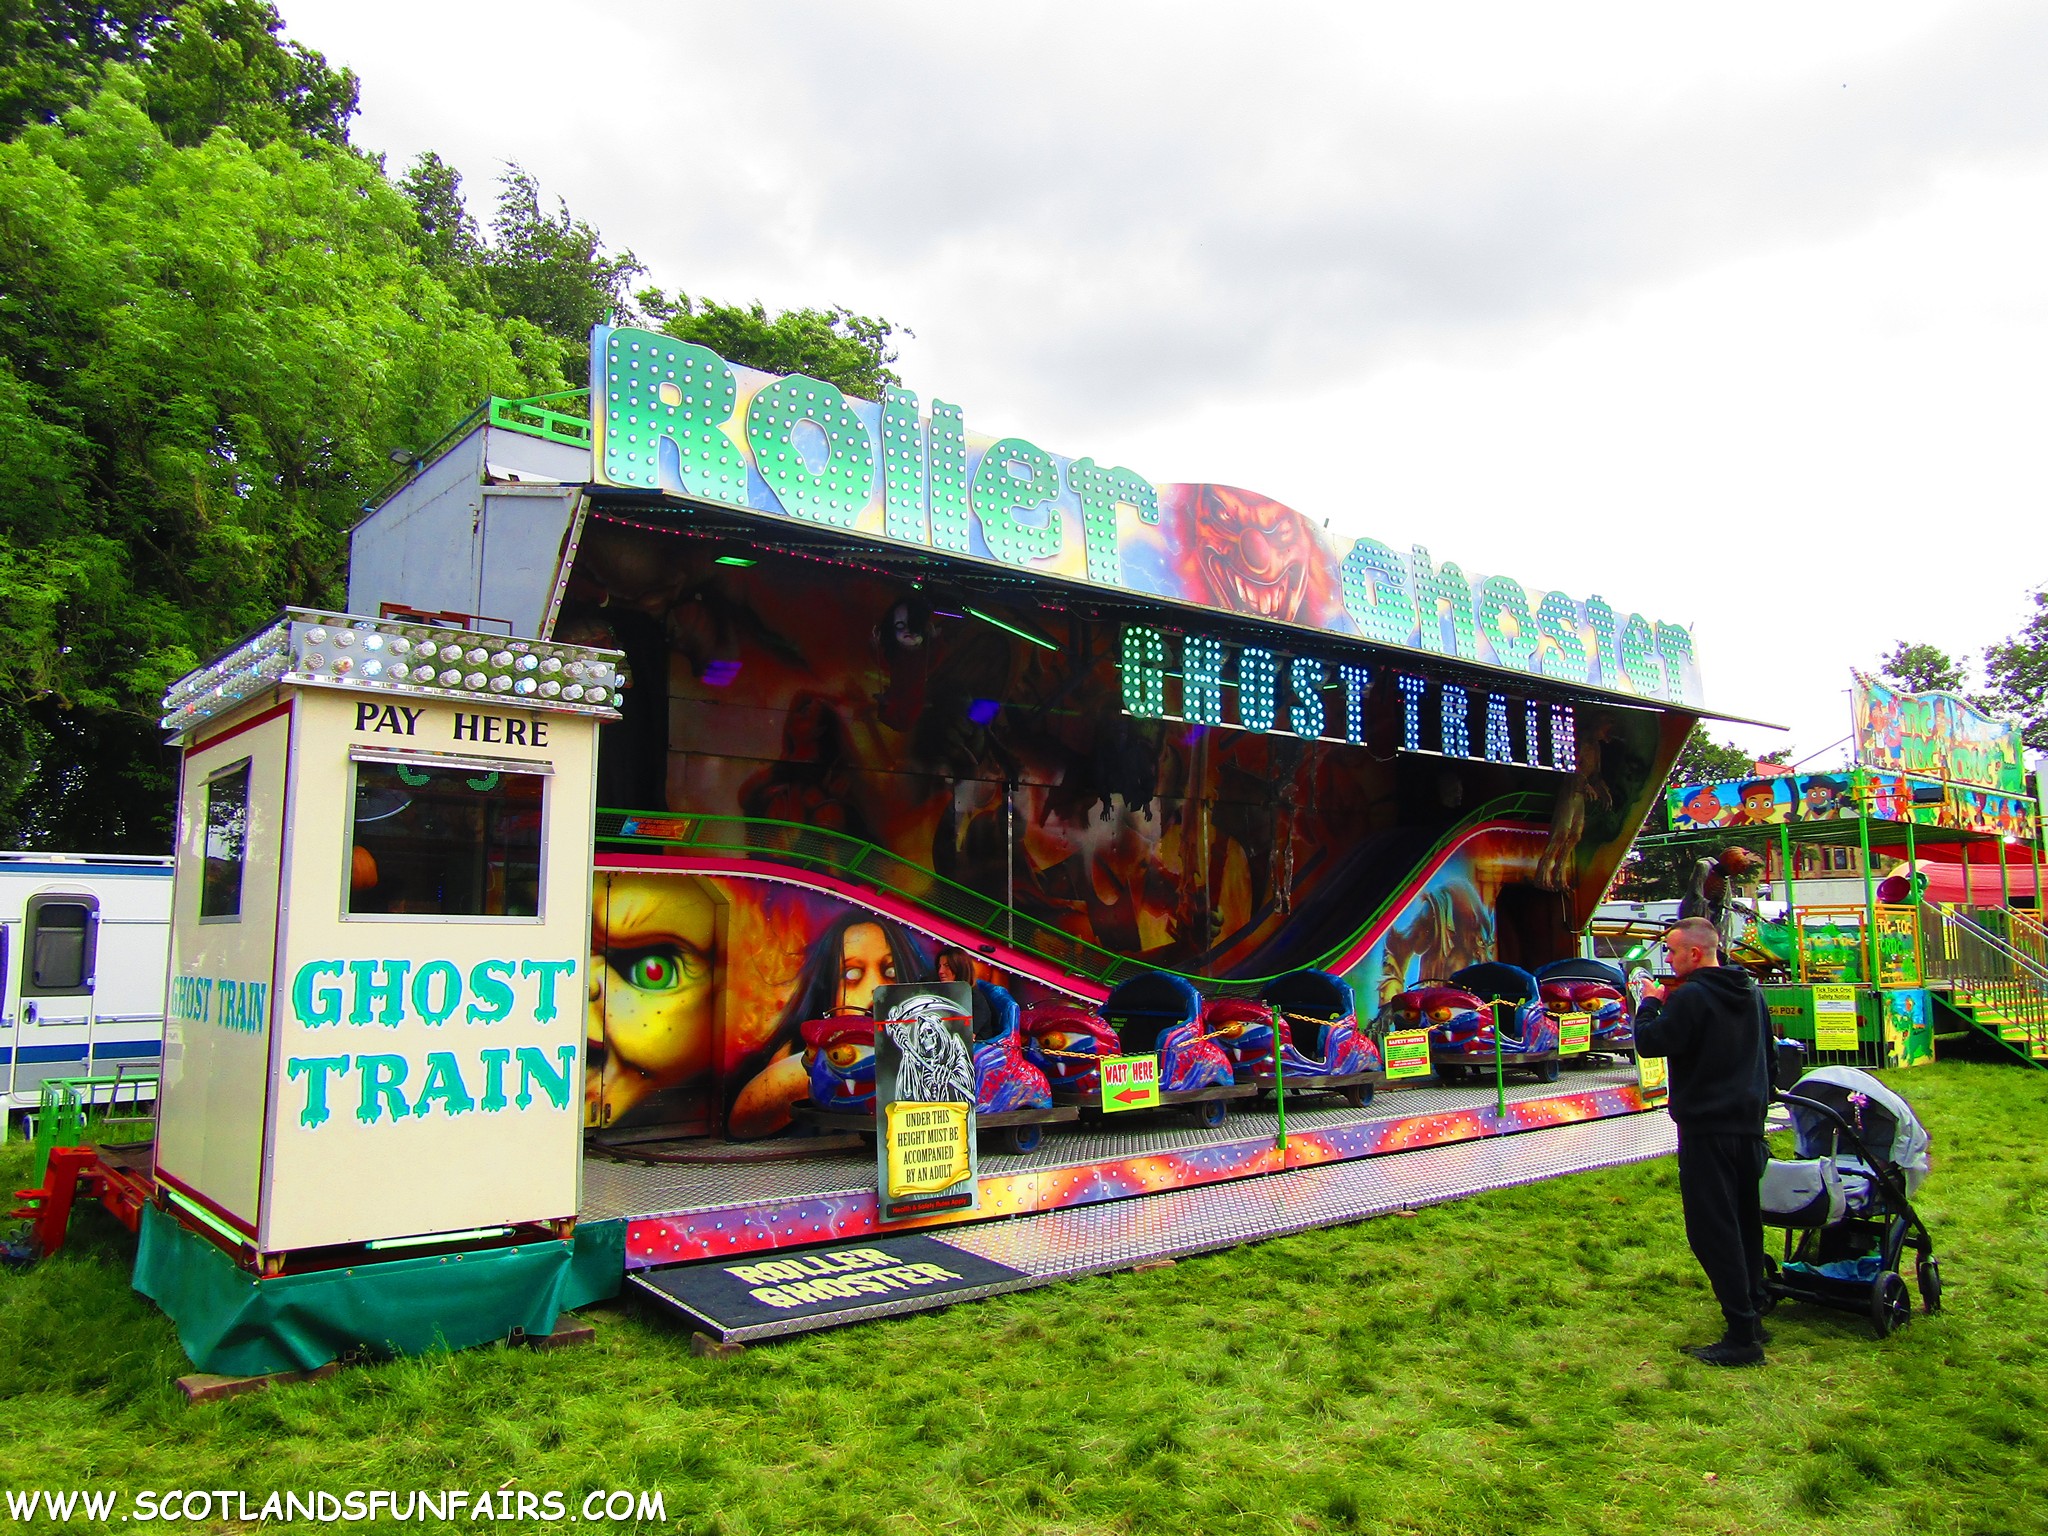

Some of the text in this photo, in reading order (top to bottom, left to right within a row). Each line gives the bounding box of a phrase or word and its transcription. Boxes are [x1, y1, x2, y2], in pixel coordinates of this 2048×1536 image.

[1122, 627, 1577, 773] GHOST TRAIN
[354, 702, 549, 747] PAY HERE
[172, 976, 267, 1036] GHOST TRAIN
[292, 960, 576, 1028] GHOST
[287, 1045, 576, 1129] TRAIN
[1104, 1061, 1154, 1085] WAIT HERE
[897, 1126, 959, 1147] HEIGHT MUST BE
[906, 1109, 950, 1127] UNDER THIS
[903, 1145, 954, 1165] ACCOMPANIED
[906, 1164, 953, 1183] BY AN ADULT
[893, 1205, 911, 1214] Health
[917, 1202, 935, 1210] Safety
[951, 1198, 967, 1206] Apply
[723, 1248, 903, 1285] ROLLER
[749, 1262, 964, 1308] GHOSTER
